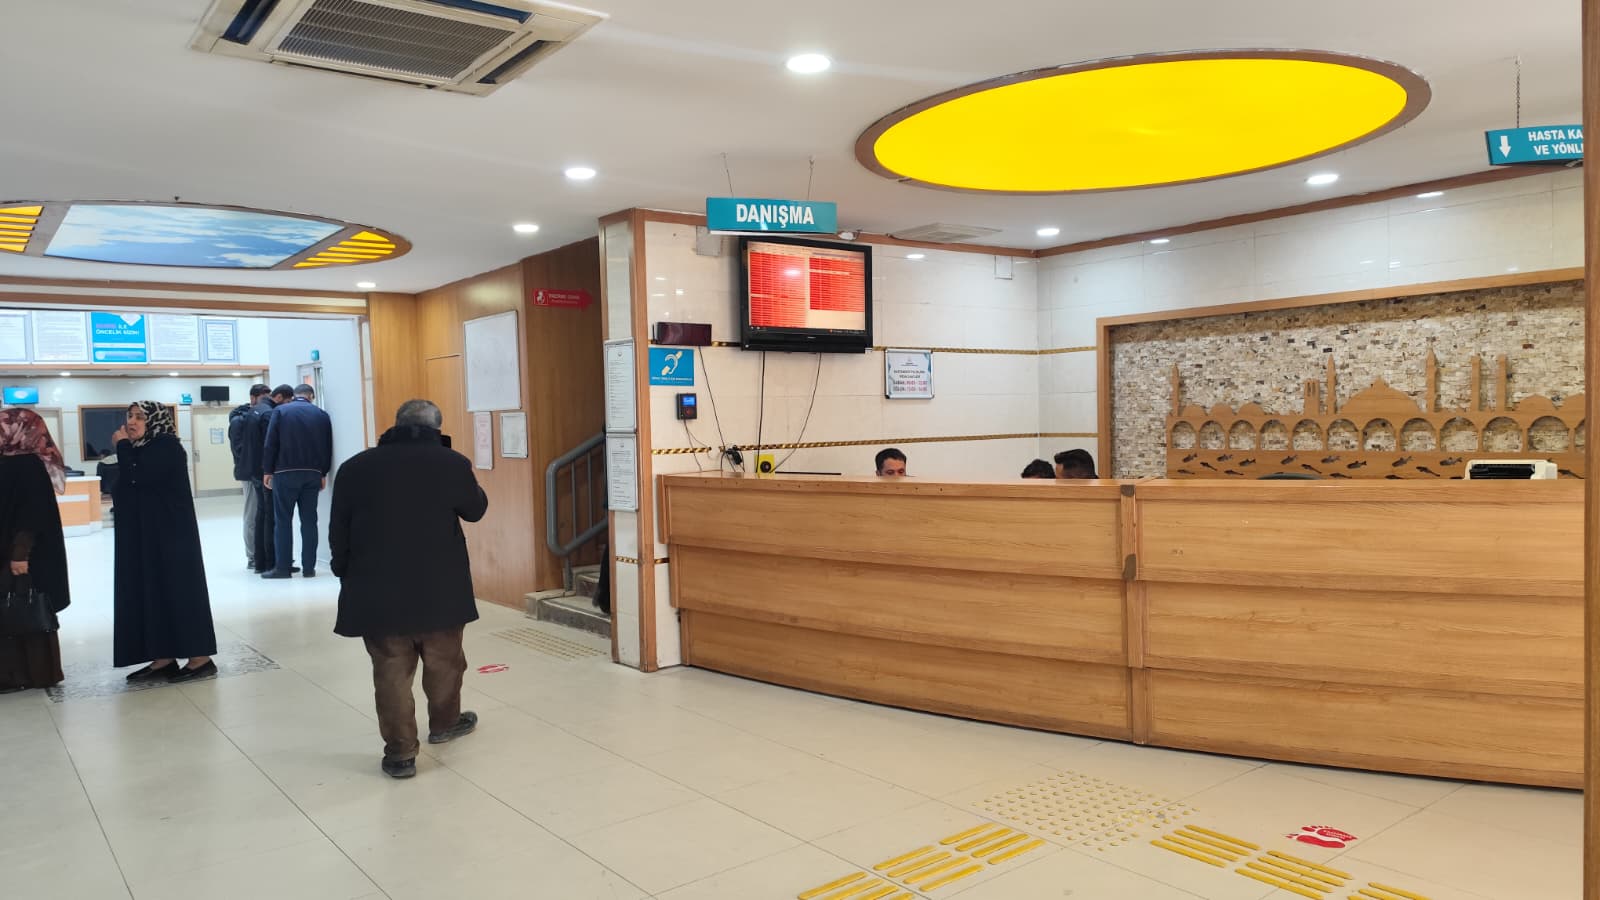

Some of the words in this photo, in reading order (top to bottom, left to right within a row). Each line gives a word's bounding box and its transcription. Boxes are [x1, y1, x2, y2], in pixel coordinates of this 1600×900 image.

[1528, 130, 1565, 141] HASTA
[1533, 145, 1550, 155] VE
[736, 204, 814, 228] DANIŞMA
